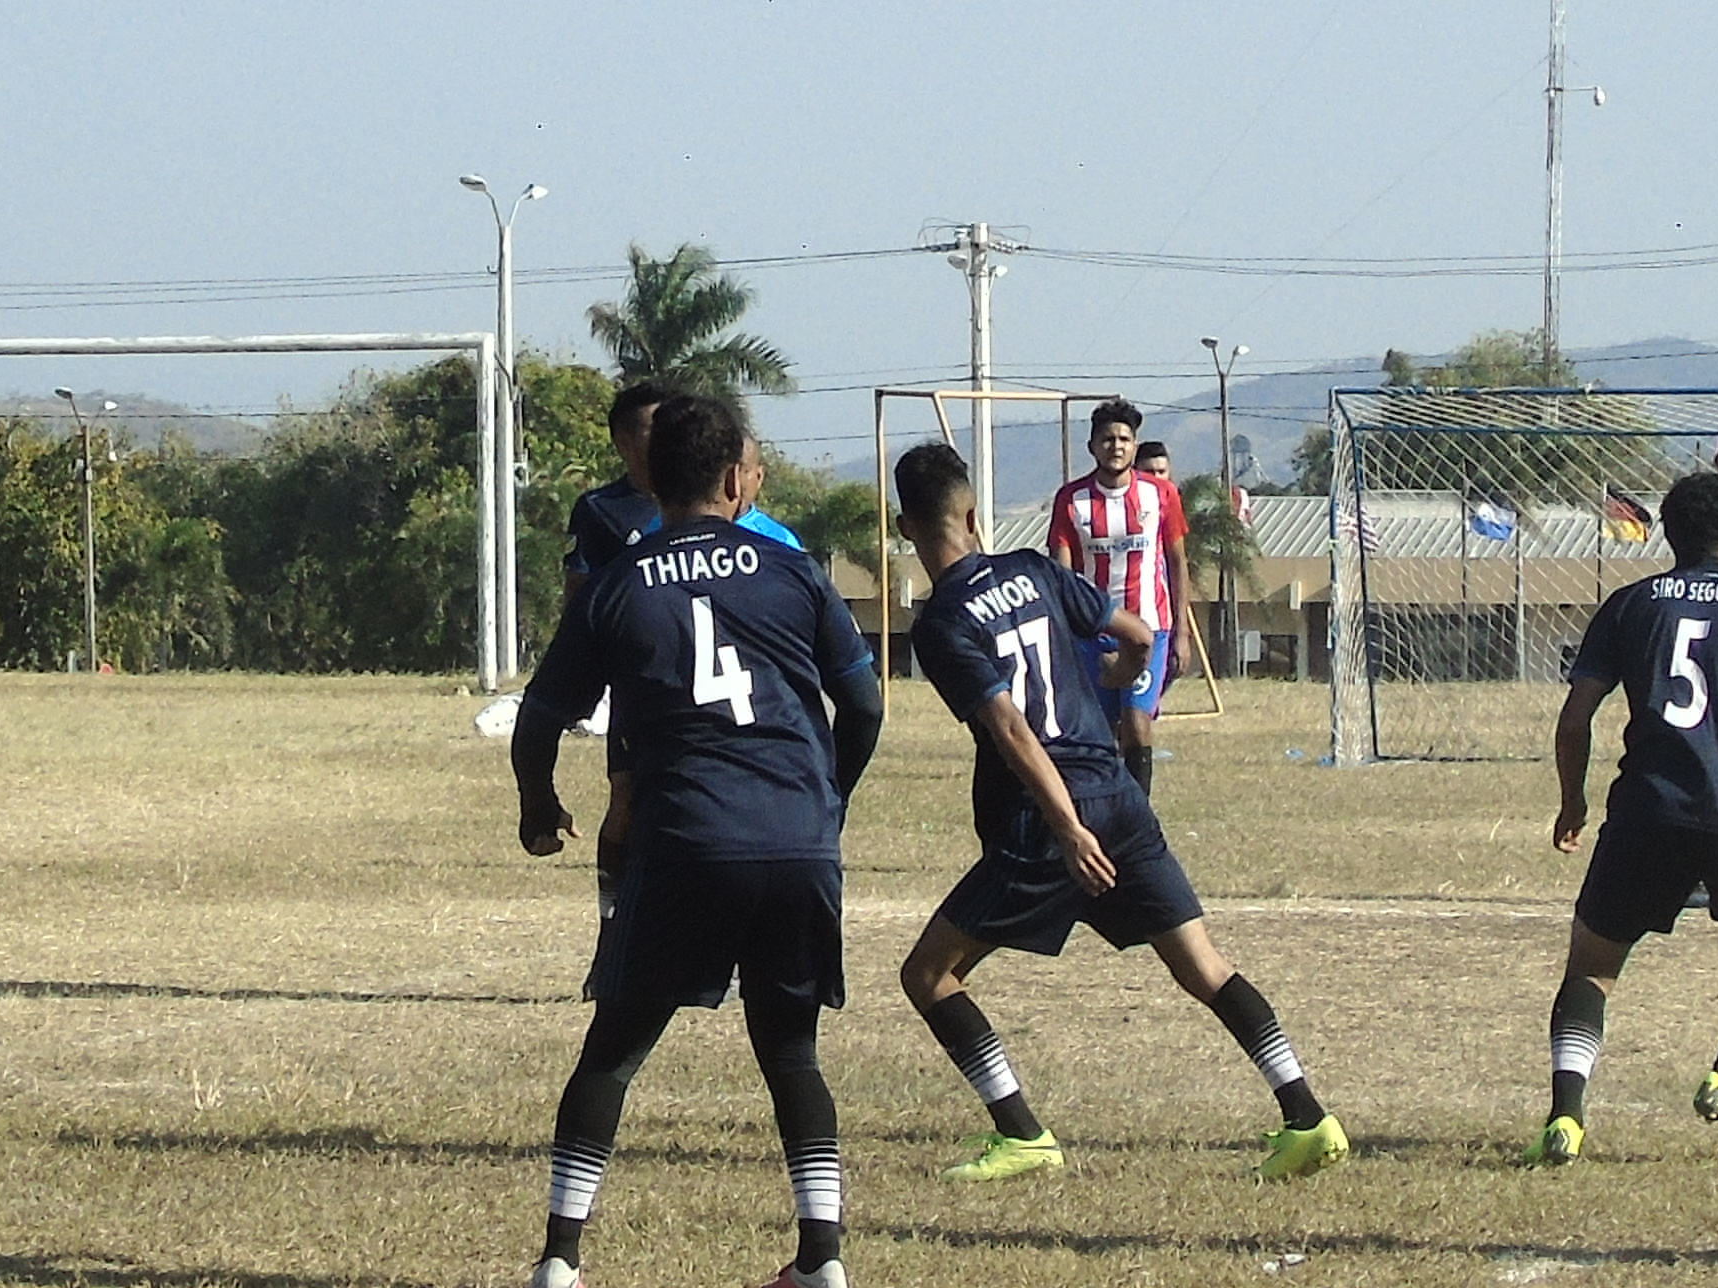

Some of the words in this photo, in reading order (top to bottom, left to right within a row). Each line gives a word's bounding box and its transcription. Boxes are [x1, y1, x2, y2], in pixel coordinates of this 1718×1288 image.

[636, 544, 759, 588] THIAGO
[691, 595, 755, 726] 4
[995, 615, 1063, 739] 77
[1133, 669, 1151, 695] 9
[1663, 618, 1711, 729] 5
